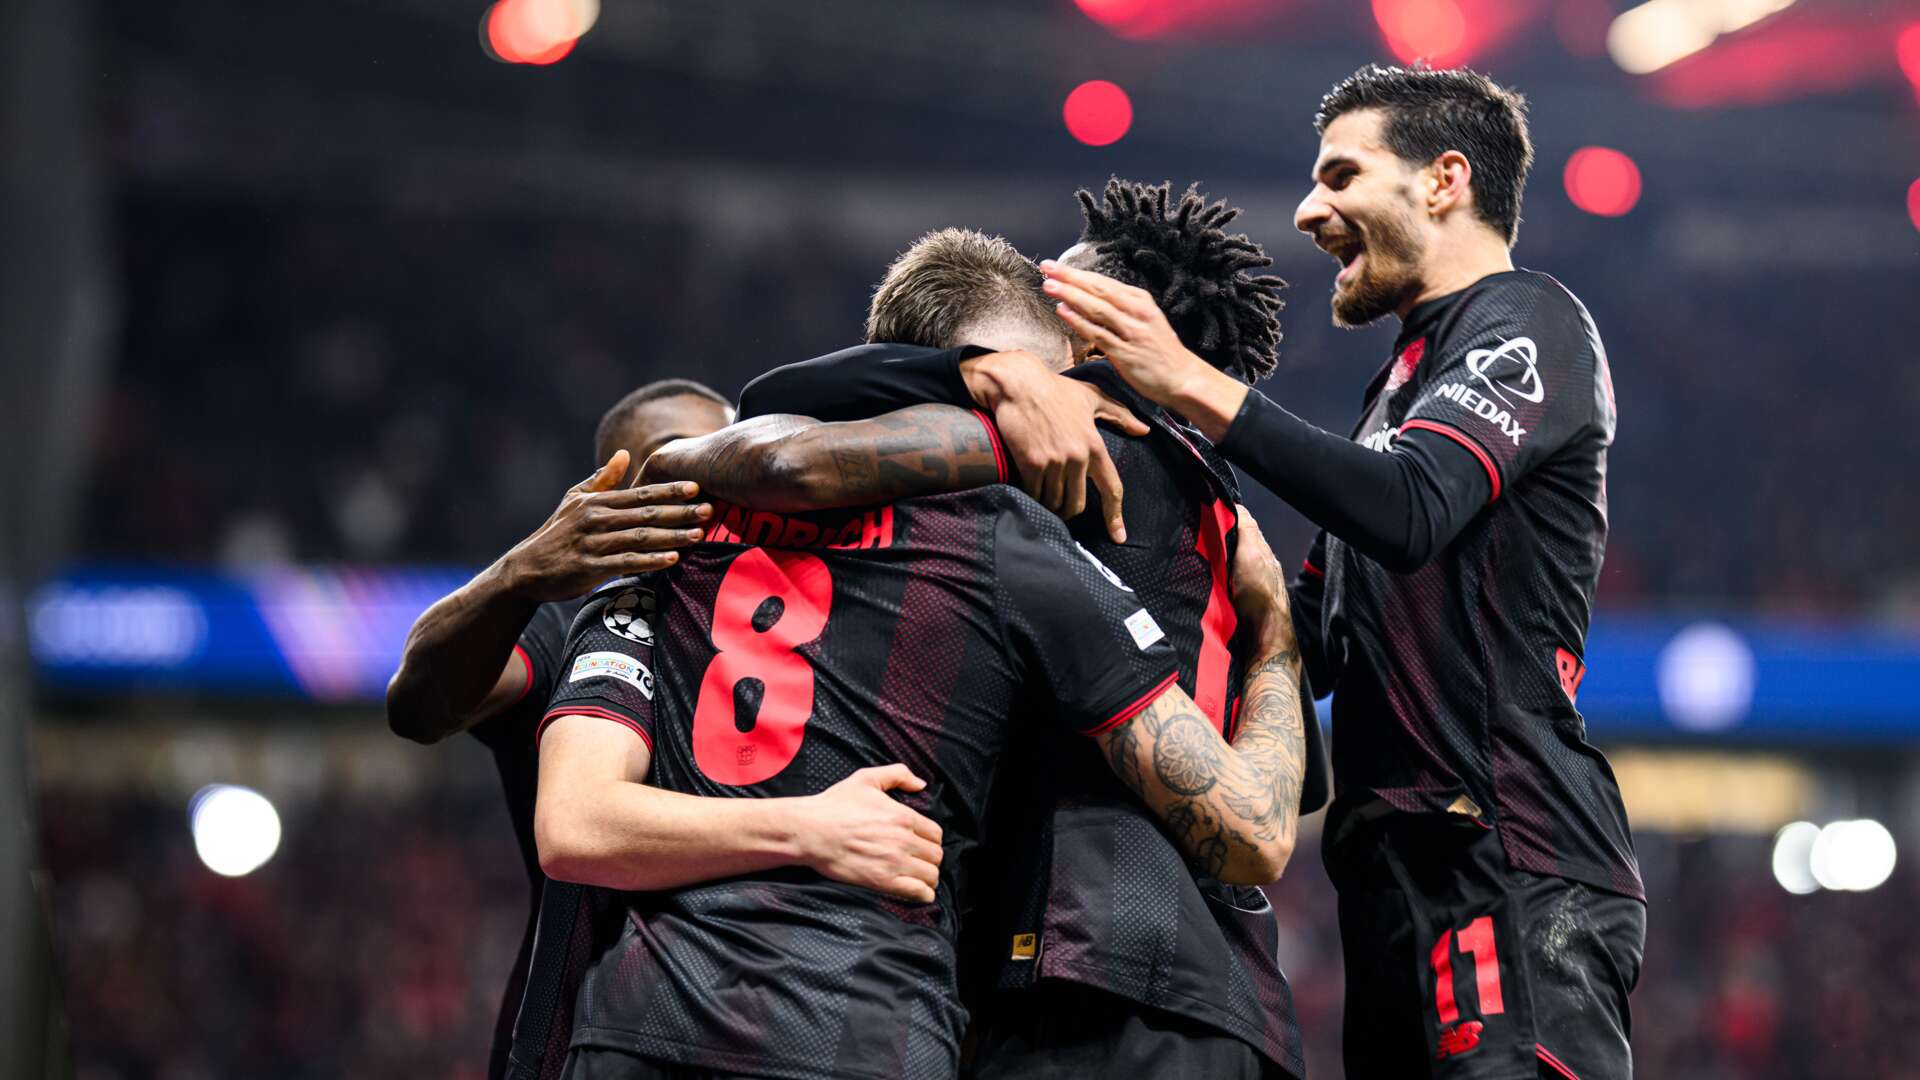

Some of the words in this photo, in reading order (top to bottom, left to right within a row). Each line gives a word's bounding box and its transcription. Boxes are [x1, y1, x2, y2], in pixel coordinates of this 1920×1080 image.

[1434, 382, 1527, 446] NIEDAX
[704, 504, 894, 550] NDRICH
[692, 546, 833, 786] 8
